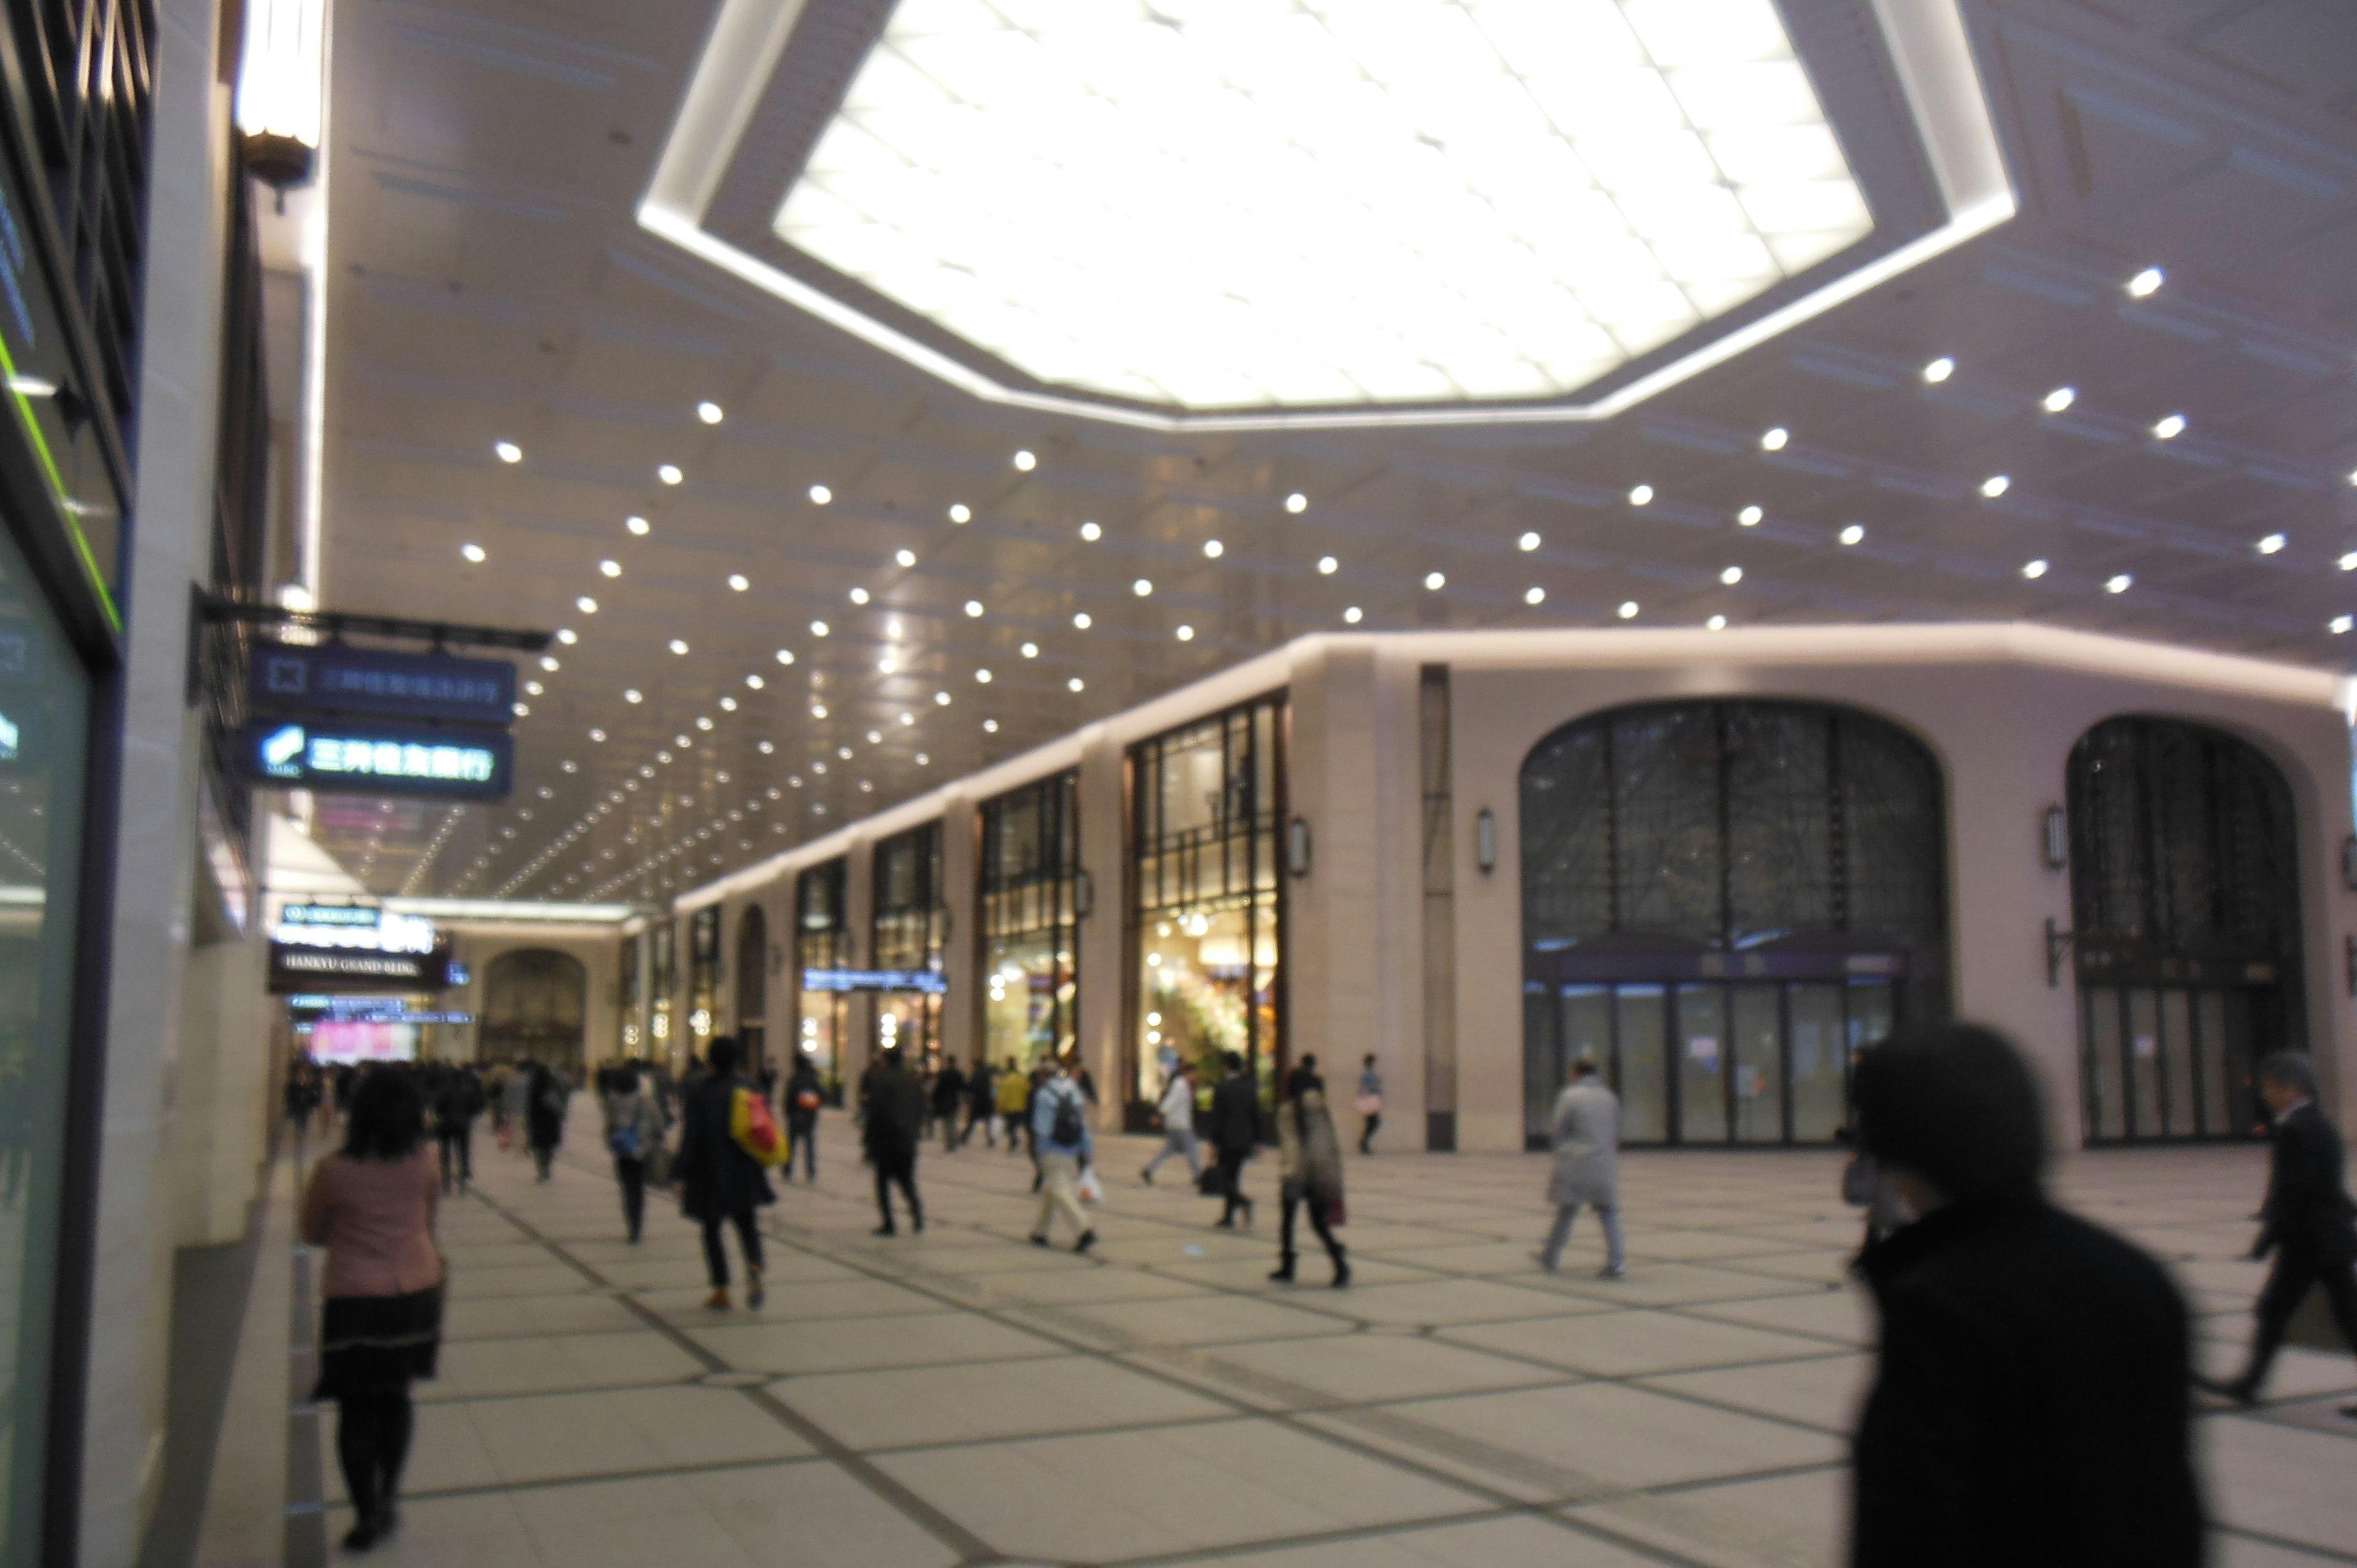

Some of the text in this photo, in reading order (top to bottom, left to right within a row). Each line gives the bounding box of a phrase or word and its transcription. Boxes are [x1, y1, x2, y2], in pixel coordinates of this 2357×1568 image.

[311, 738, 493, 781] 三井住友銀行
[285, 955, 337, 970] HANKYU
[339, 958, 381, 972] GRAND
